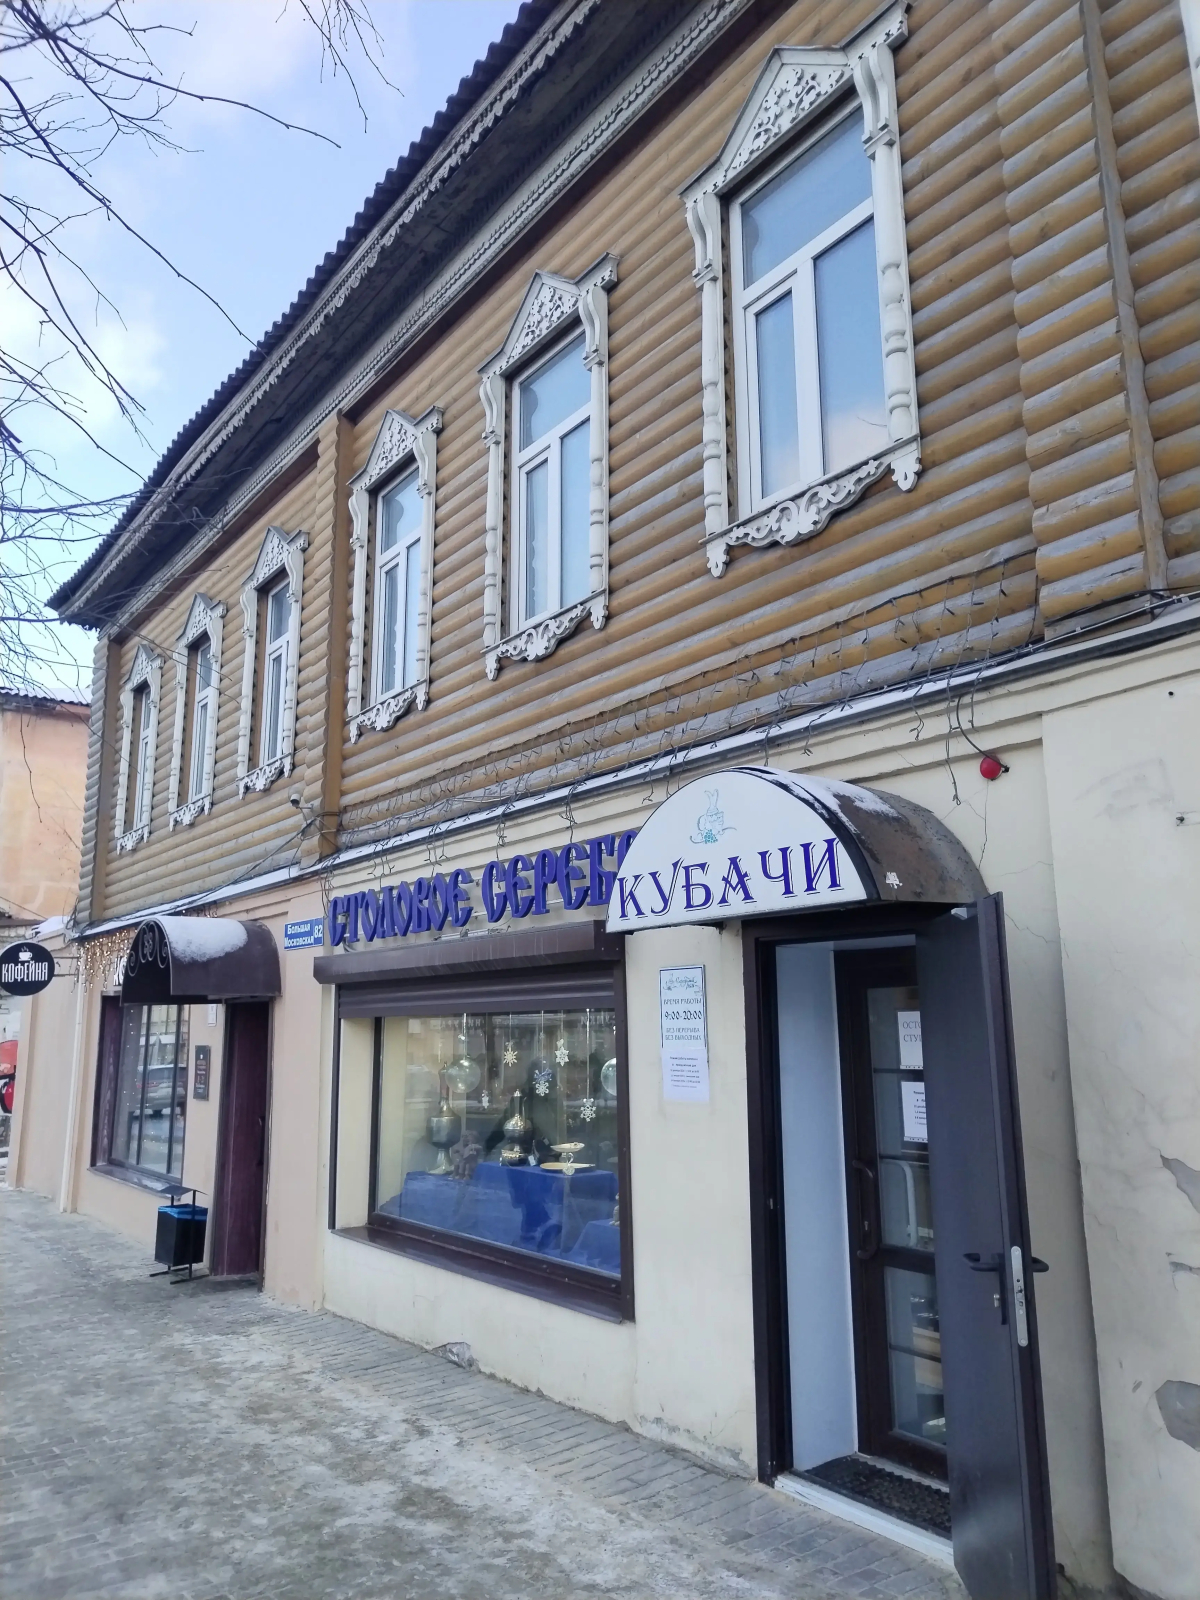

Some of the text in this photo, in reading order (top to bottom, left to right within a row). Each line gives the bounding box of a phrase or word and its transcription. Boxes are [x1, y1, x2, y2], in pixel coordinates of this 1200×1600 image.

[617, 837, 844, 921] КУБАЧИ
[328, 868, 474, 946] СТОЛОВОЕ
[287, 923, 311, 935] Большая
[314, 924, 323, 938] 82
[284, 935, 314, 947] Московская
[1, 960, 49, 983] КОФЕЙНЯ
